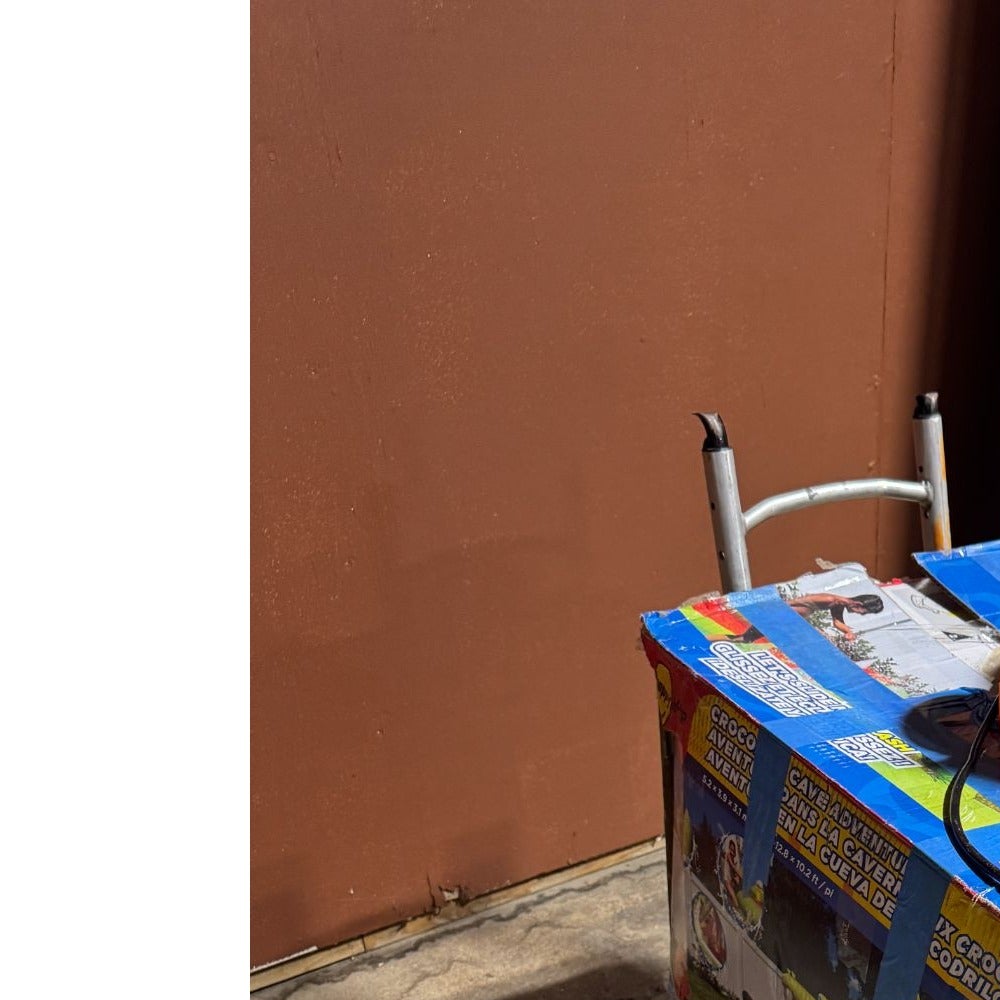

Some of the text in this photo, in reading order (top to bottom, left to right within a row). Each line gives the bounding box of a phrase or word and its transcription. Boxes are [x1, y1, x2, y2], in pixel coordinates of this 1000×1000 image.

[701, 774, 713, 789] 5.2
[718, 788, 728, 805] 3.9
[788, 766, 830, 811] CAVE
[818, 817, 841, 849] LA
[774, 841, 820, 886] 12.8 10.2 ft
[777, 809, 898, 920] EN LA CUEVA DE
